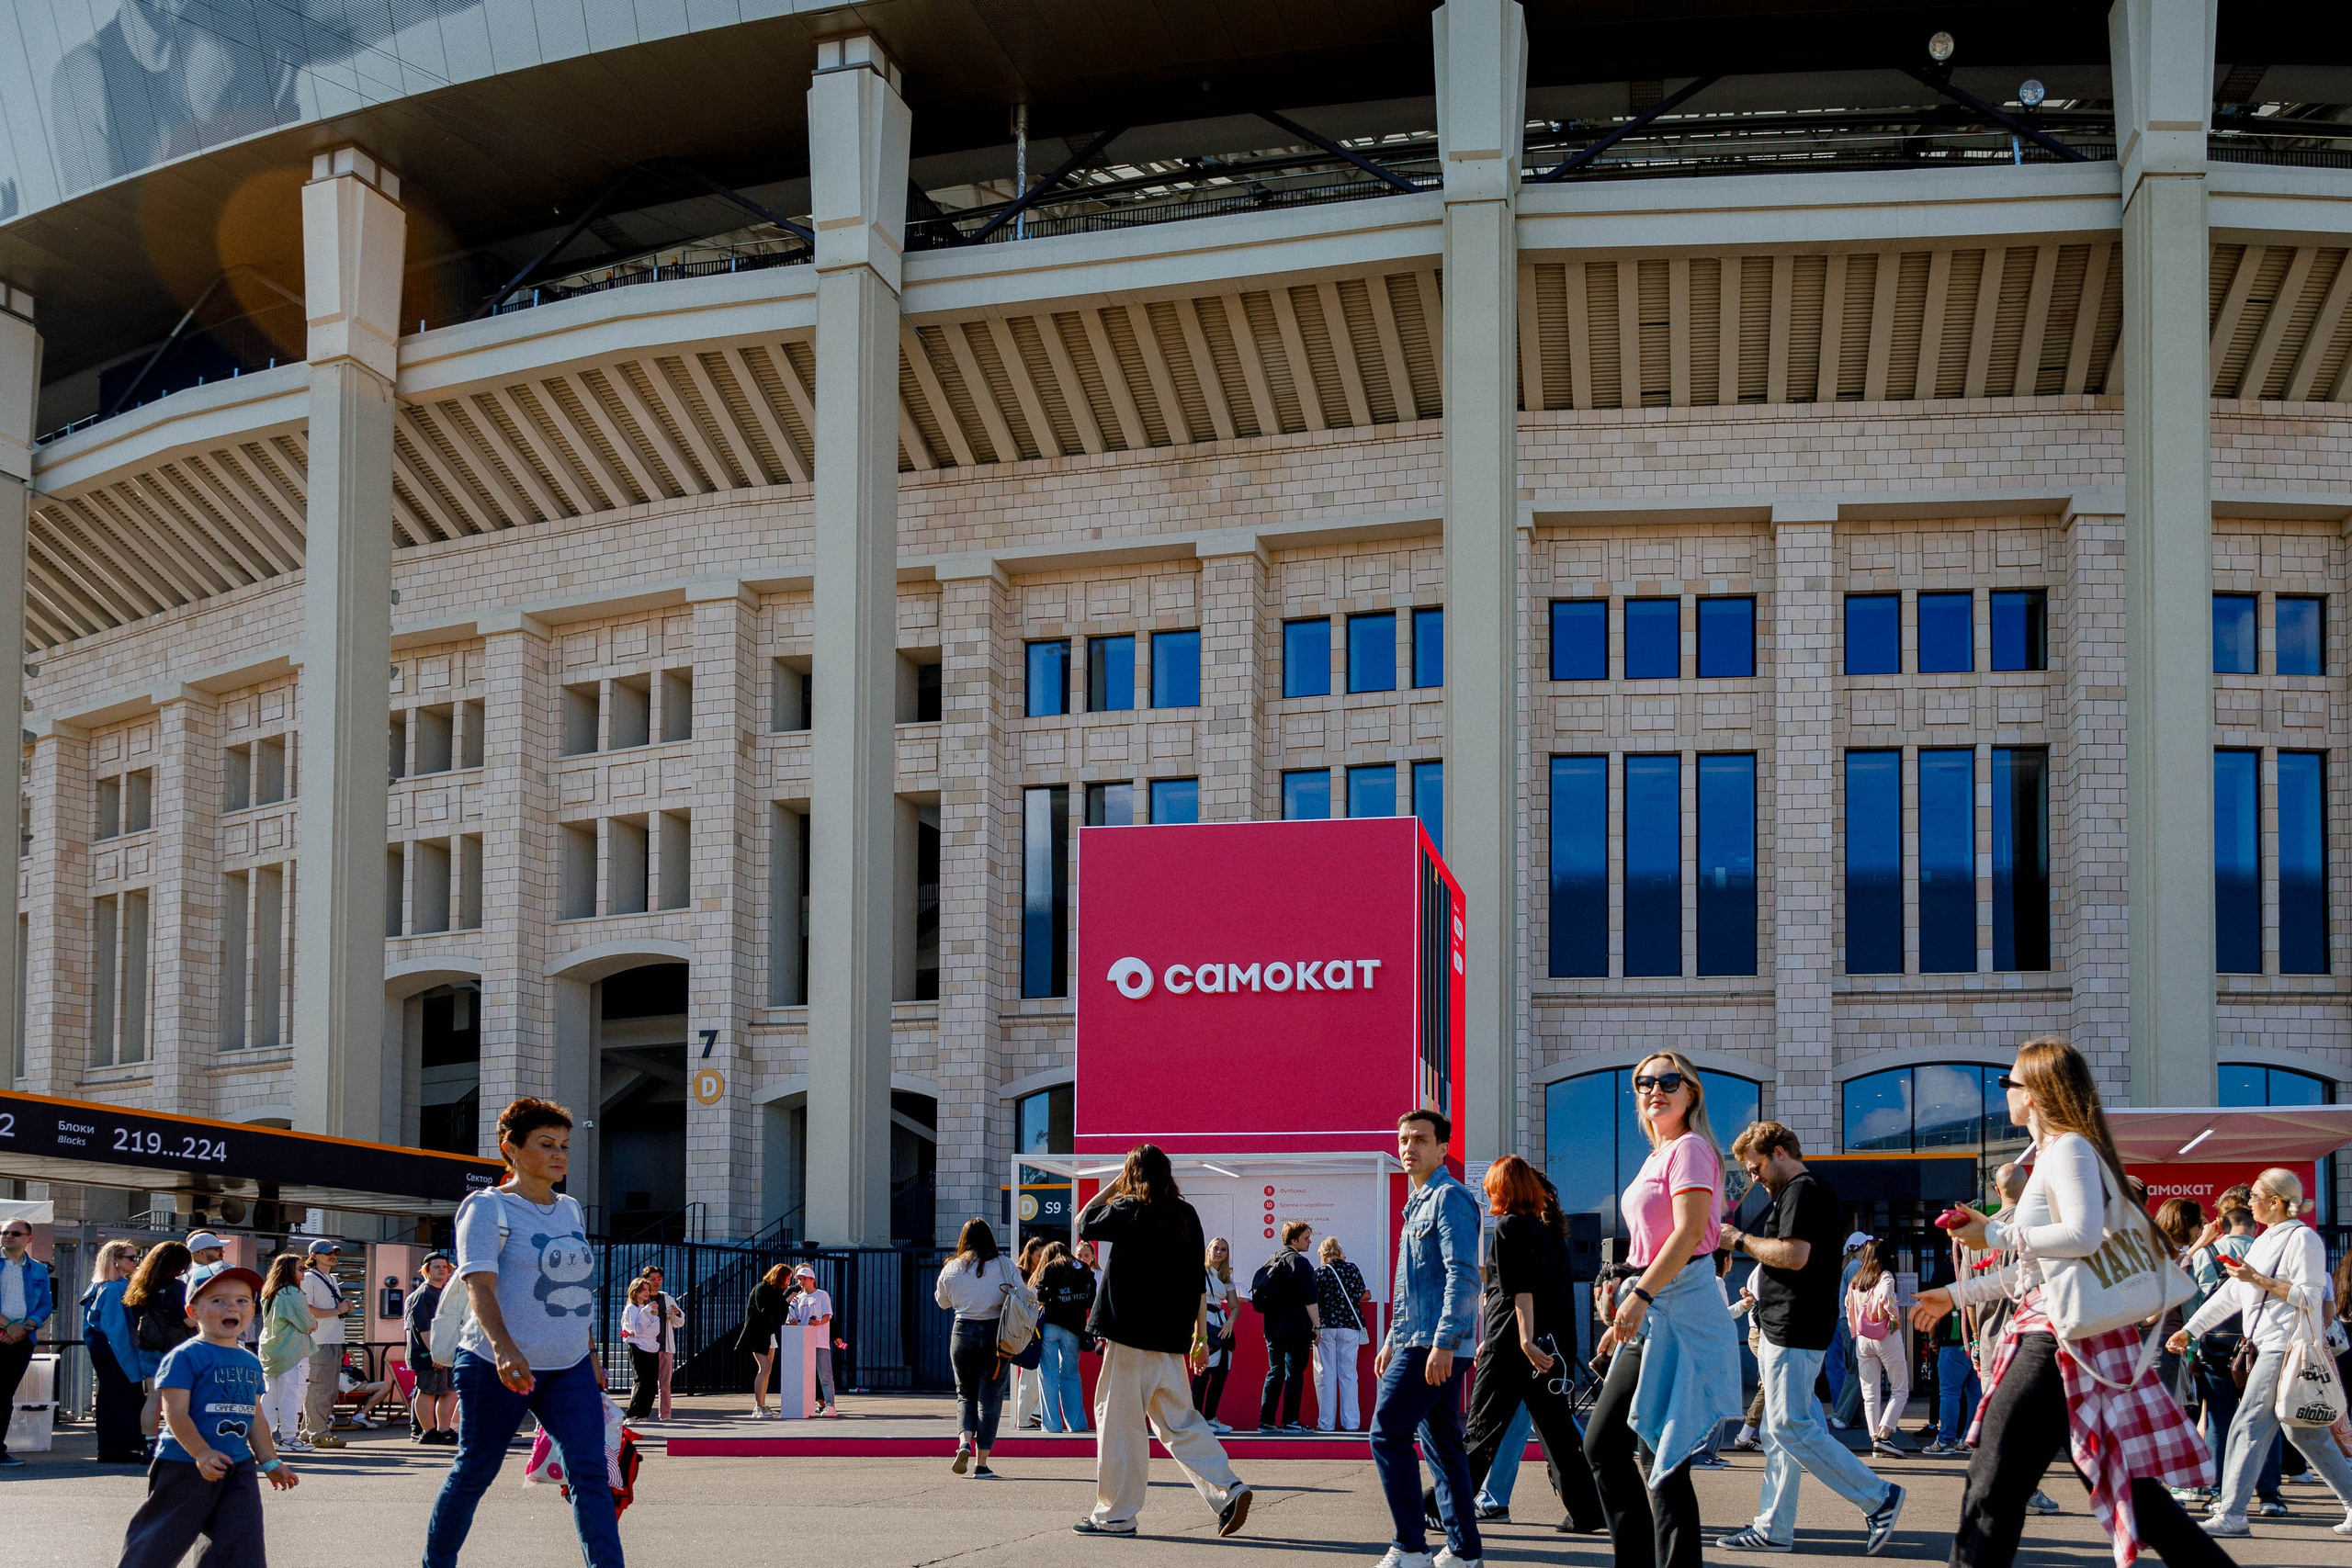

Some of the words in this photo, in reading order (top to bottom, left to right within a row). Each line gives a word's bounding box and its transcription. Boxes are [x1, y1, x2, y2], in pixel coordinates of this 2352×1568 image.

[1164, 959, 1382, 995] самокат
[699, 1030, 718, 1058] 7
[702, 1077, 717, 1097] D
[58, 1120, 95, 1134] Блоки
[57, 1134, 86, 1146] Blocks
[113, 1127, 227, 1162] 219...224
[466, 1173, 492, 1184] Сектор
[2146, 1184, 2214, 1196] амокат
[1021, 1200, 1034, 1215] D
[1045, 1201, 1061, 1214] S9
[2080, 1228, 2156, 1289] VANS
[215, 1404, 237, 1412] GAME
[238, 1404, 255, 1414] OVER
[2295, 1405, 2337, 1422] Globus
